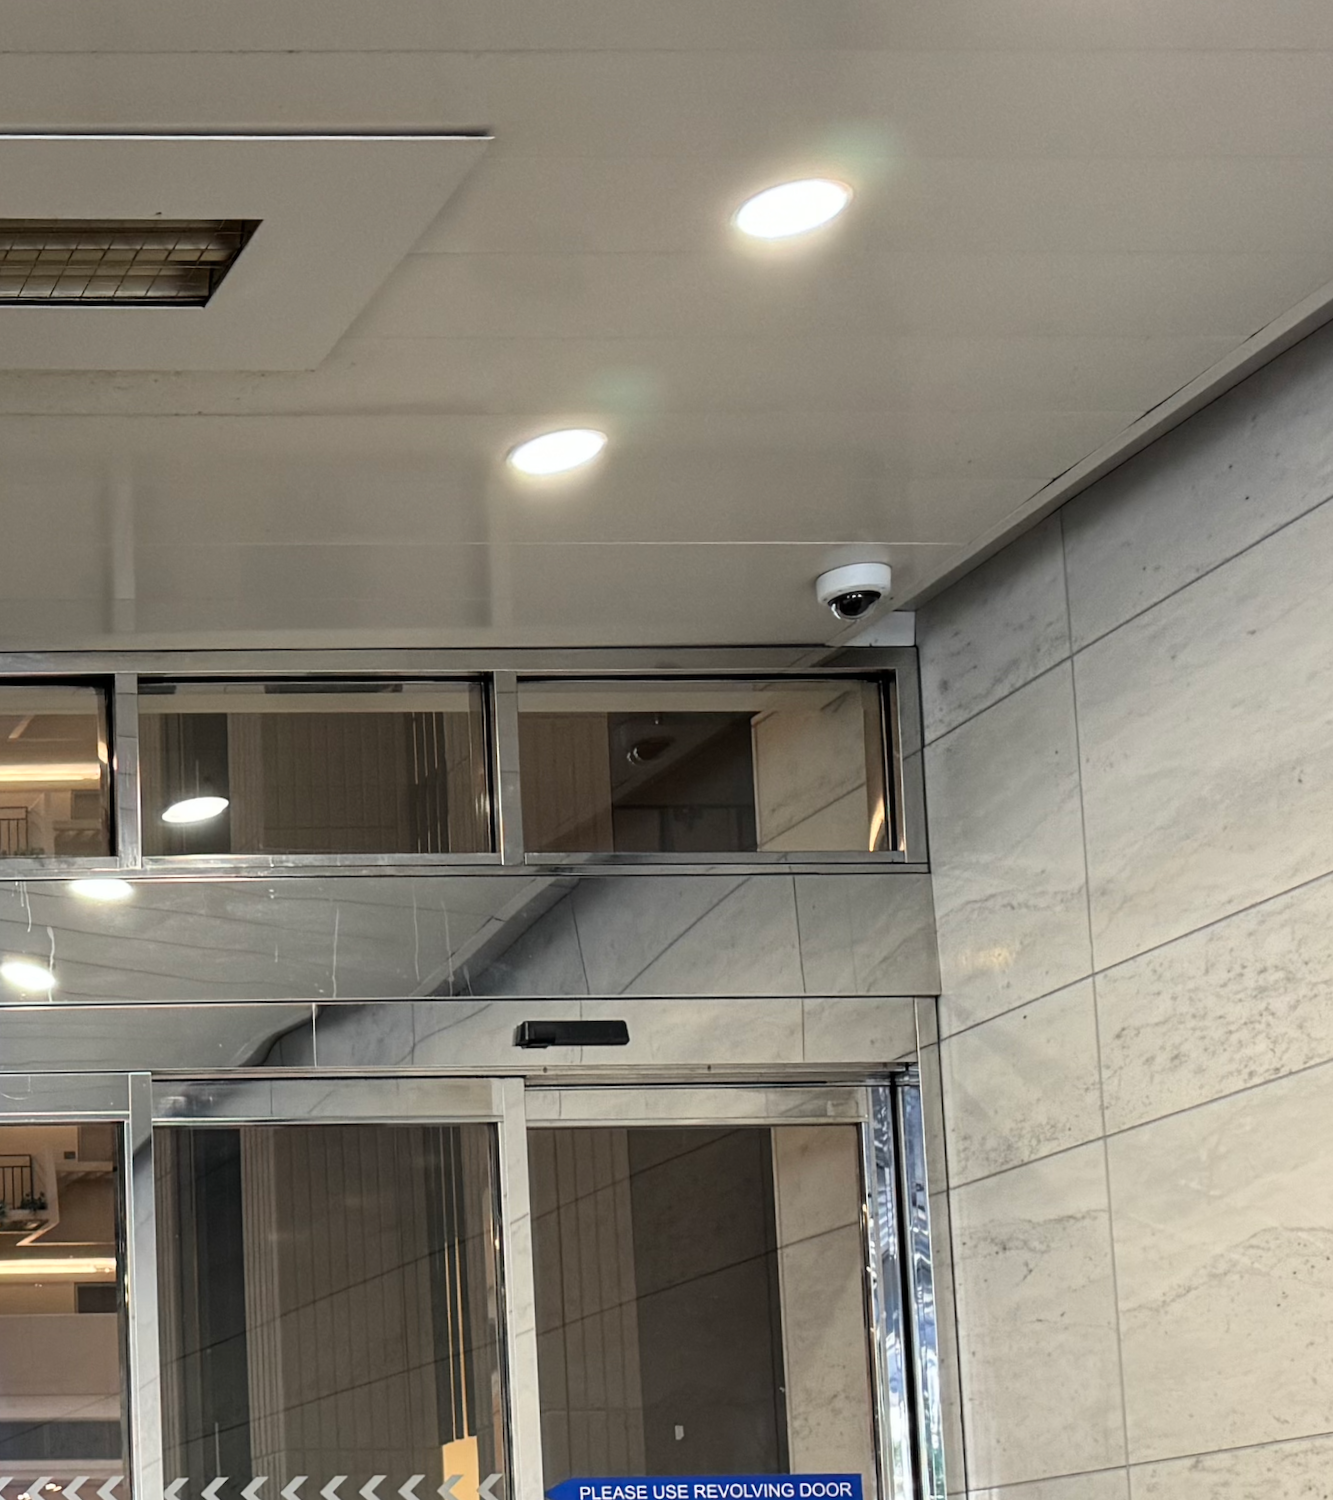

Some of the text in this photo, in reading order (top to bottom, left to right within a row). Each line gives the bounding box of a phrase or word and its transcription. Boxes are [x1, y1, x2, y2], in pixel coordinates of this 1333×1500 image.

[579, 1482, 853, 1500] PLEASE USE REVOLVING DOOR
